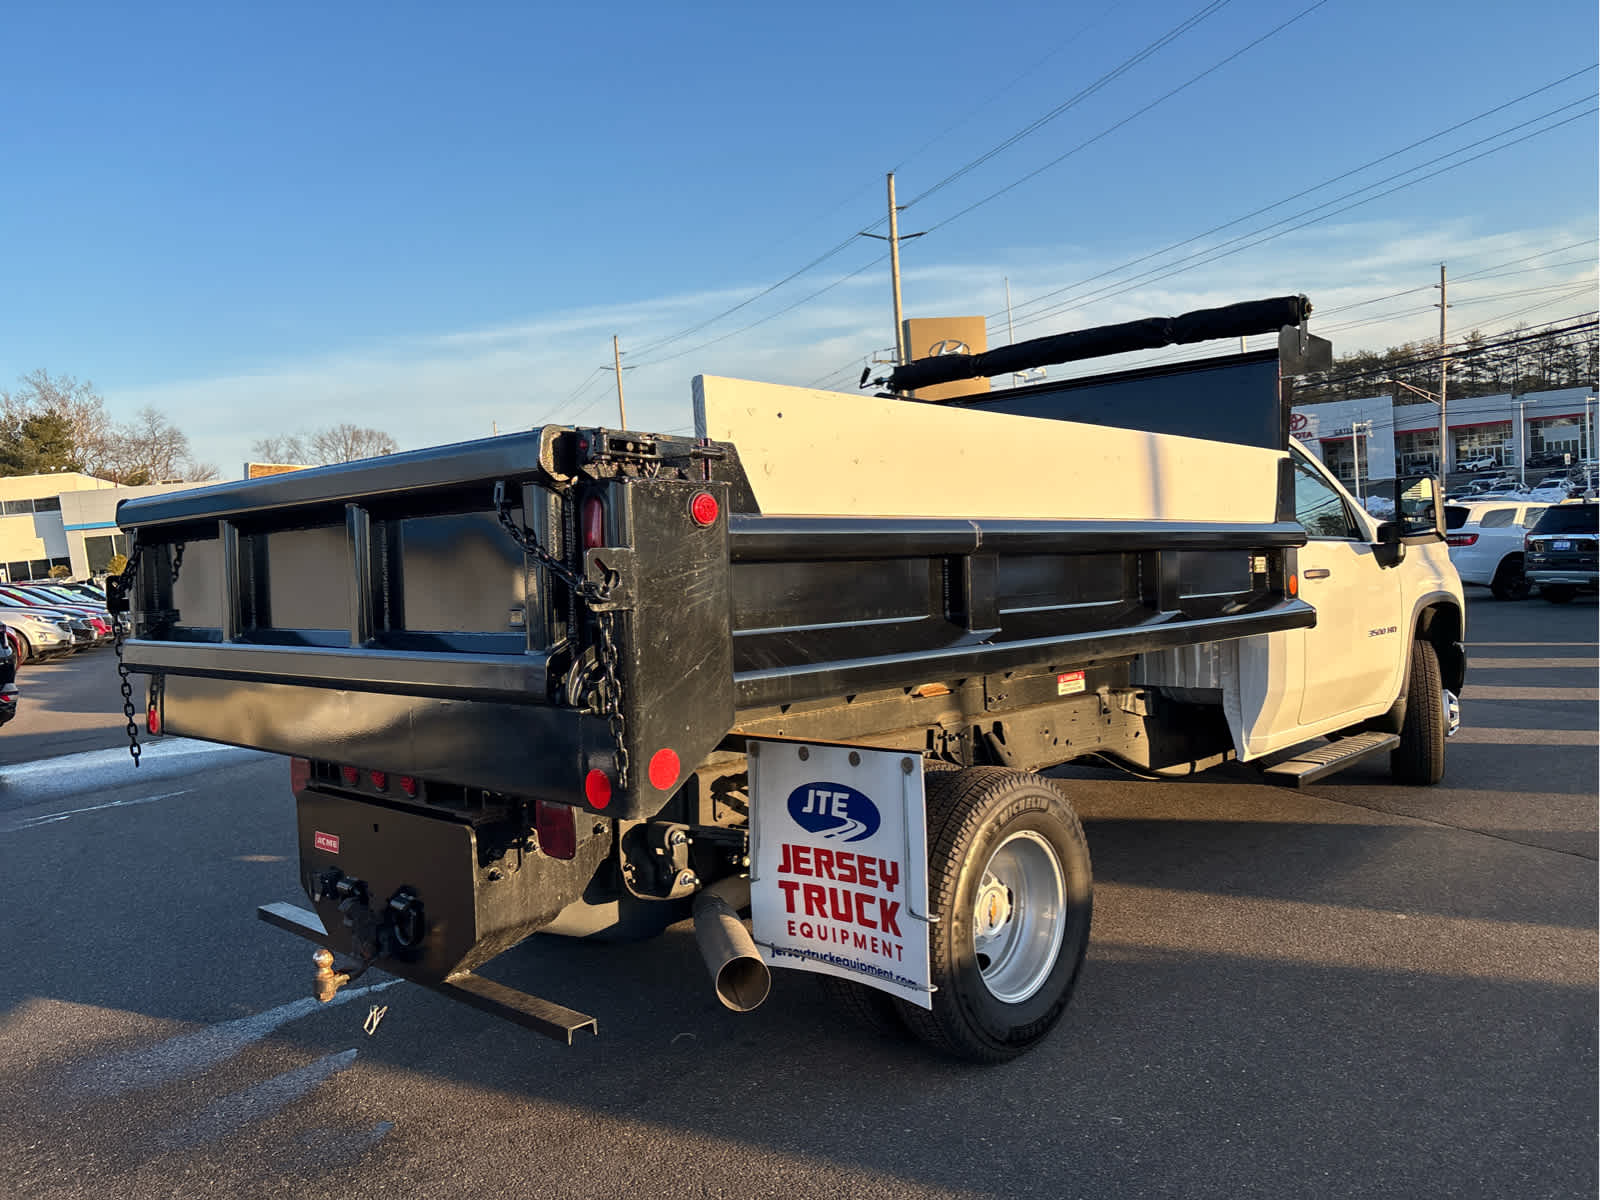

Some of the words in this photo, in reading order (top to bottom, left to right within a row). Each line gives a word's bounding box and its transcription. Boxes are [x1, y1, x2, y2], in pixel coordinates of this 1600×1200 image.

[1368, 627, 1386, 637] 3500
[1387, 625, 1397, 634] HD
[801, 789, 850, 819] JTE
[999, 796, 1049, 825] MICHELIN
[317, 837, 336, 849] ACME
[777, 843, 900, 893] JERSEY
[777, 880, 903, 938] TRUCK
[787, 920, 904, 963] EQUIPMENT
[770, 943, 918, 991] jerseytruckequipment.com
